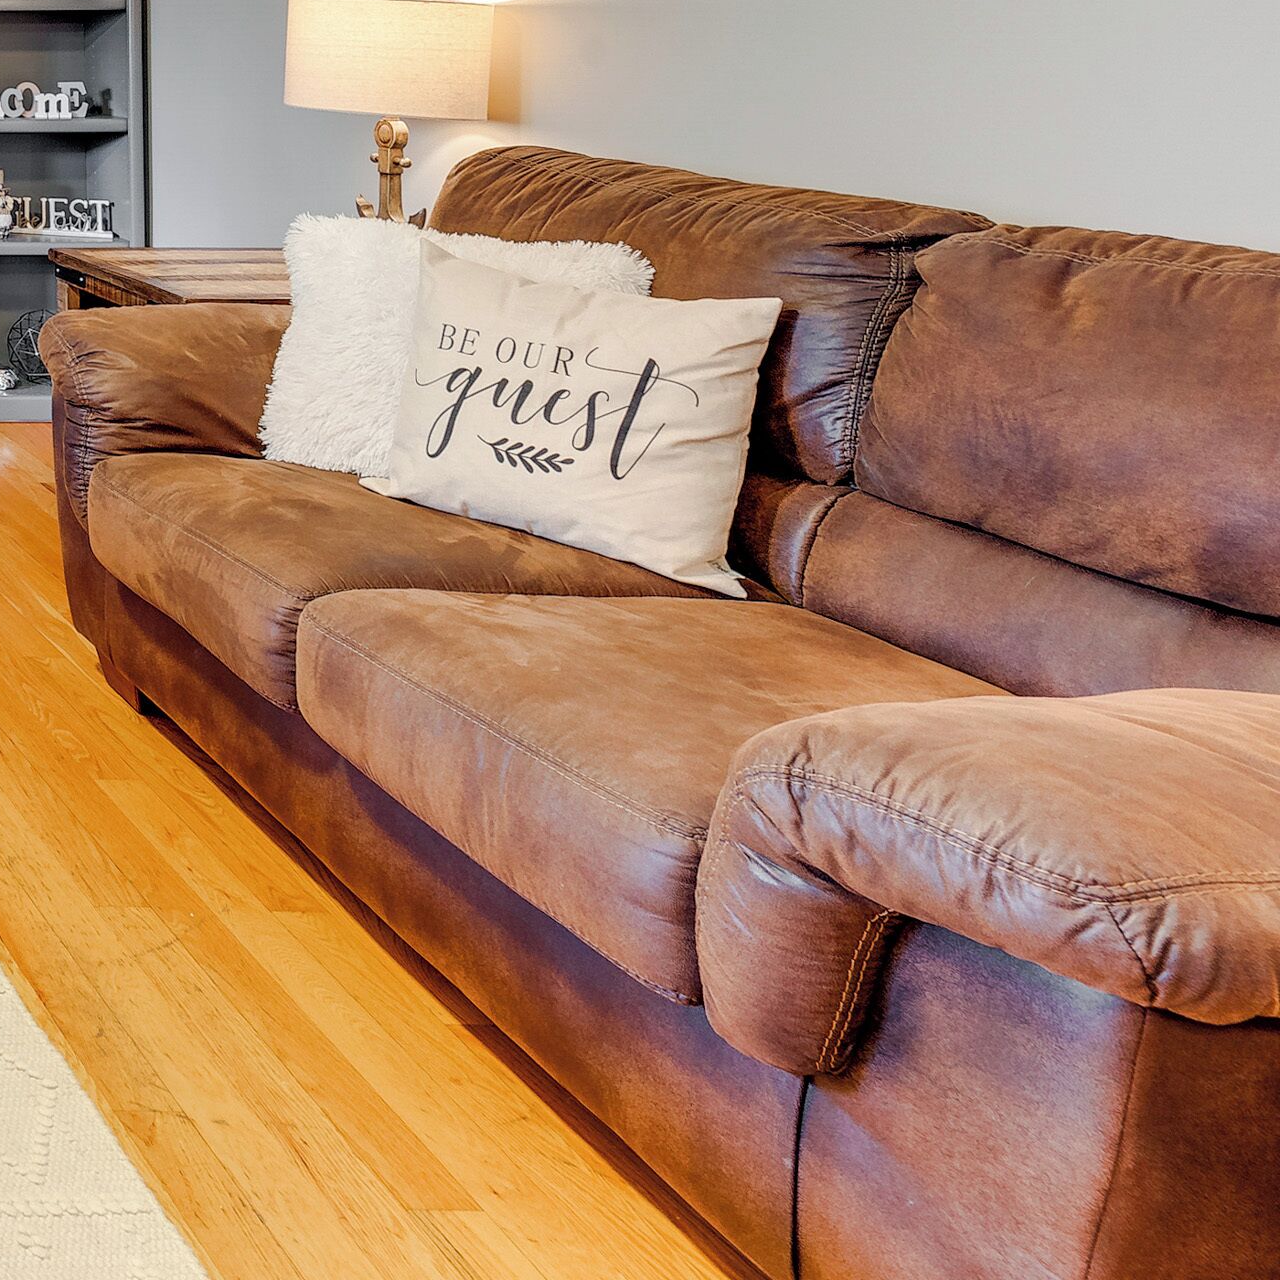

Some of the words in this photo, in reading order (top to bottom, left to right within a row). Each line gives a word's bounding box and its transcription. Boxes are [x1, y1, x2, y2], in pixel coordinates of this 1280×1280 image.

[436, 323, 481, 356] BE
[495, 336, 575, 377] OUR
[415, 347, 700, 480] guest
